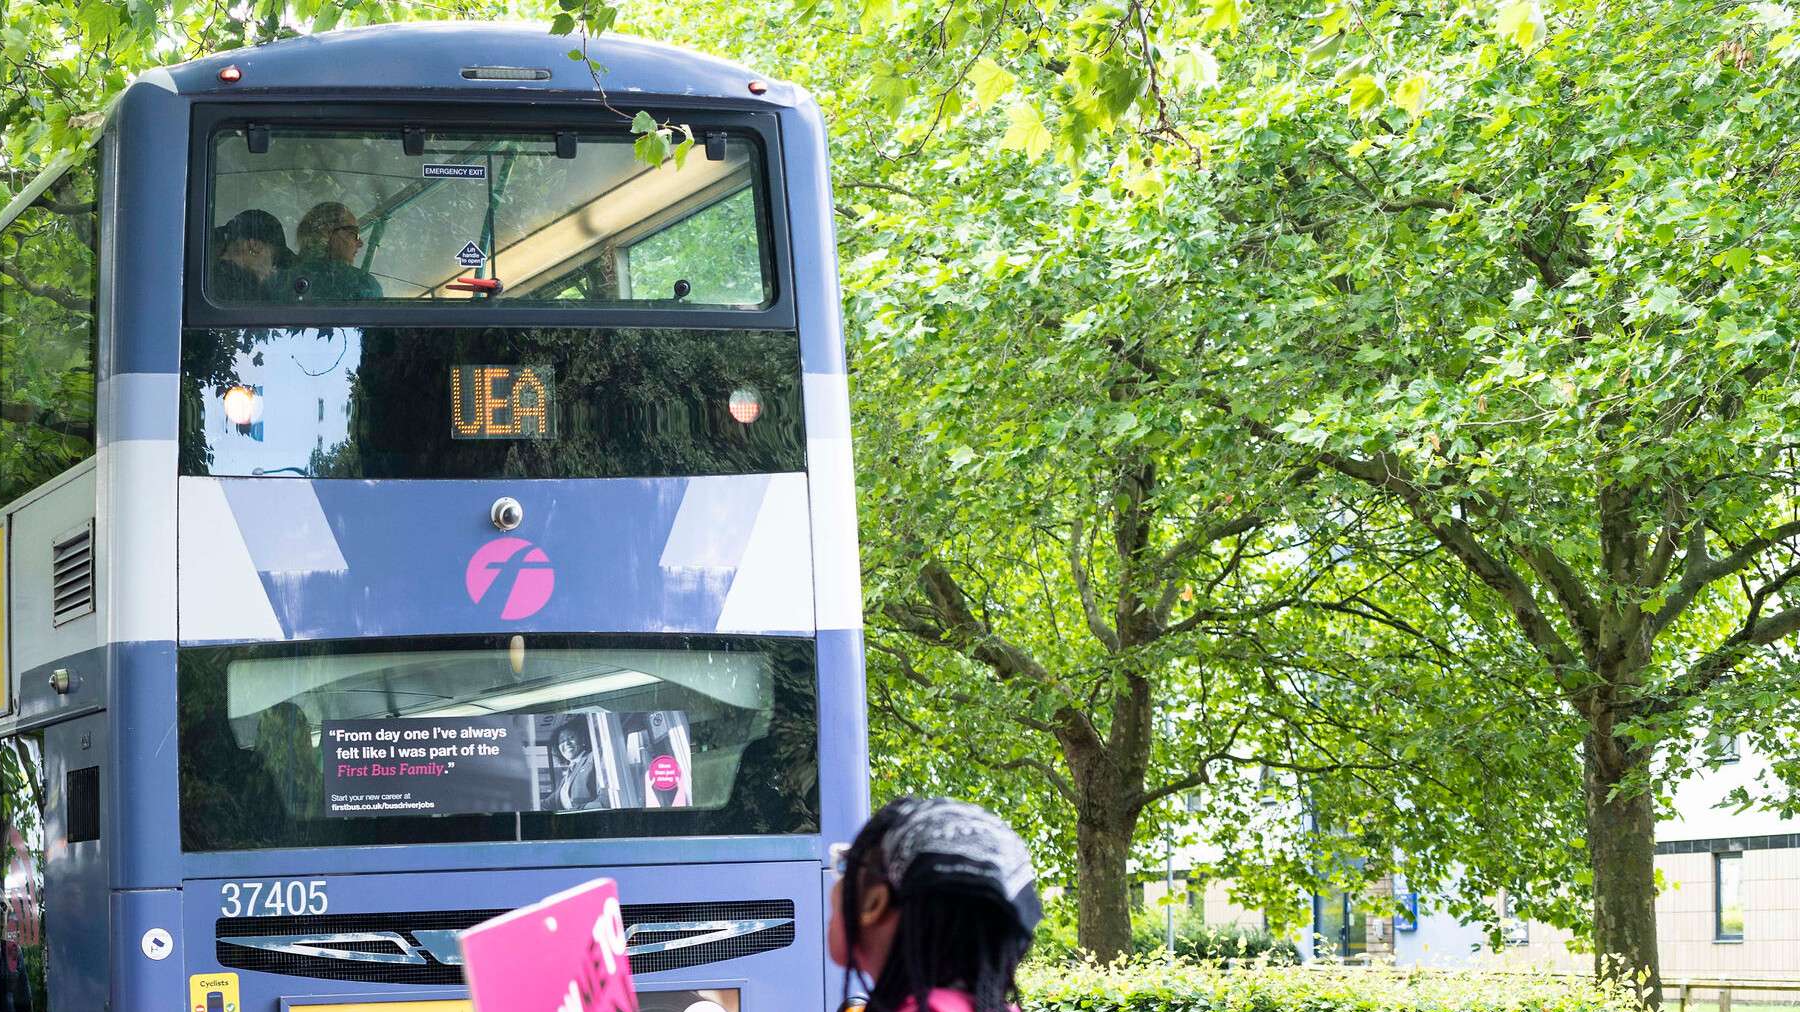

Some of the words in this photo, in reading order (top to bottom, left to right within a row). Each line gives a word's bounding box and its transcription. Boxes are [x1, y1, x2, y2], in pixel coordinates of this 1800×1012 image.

[452, 368, 546, 434] UEA
[375, 728, 400, 743] day
[404, 731, 429, 741] one
[460, 726, 507, 739] always
[336, 748, 359, 759] felt
[362, 747, 387, 759] like
[390, 746, 395, 758] I
[398, 747, 426, 757] was
[429, 745, 457, 759] part
[460, 744, 474, 756] of
[476, 744, 500, 756] the
[337, 764, 368, 777] First
[371, 764, 396, 776] Bus
[331, 794, 348, 802] Start
[331, 801, 435, 812] firstbus.co.uk/busdriverjobs
[221, 880, 328, 917] 37405
[199, 980, 230, 989] Cyclists
